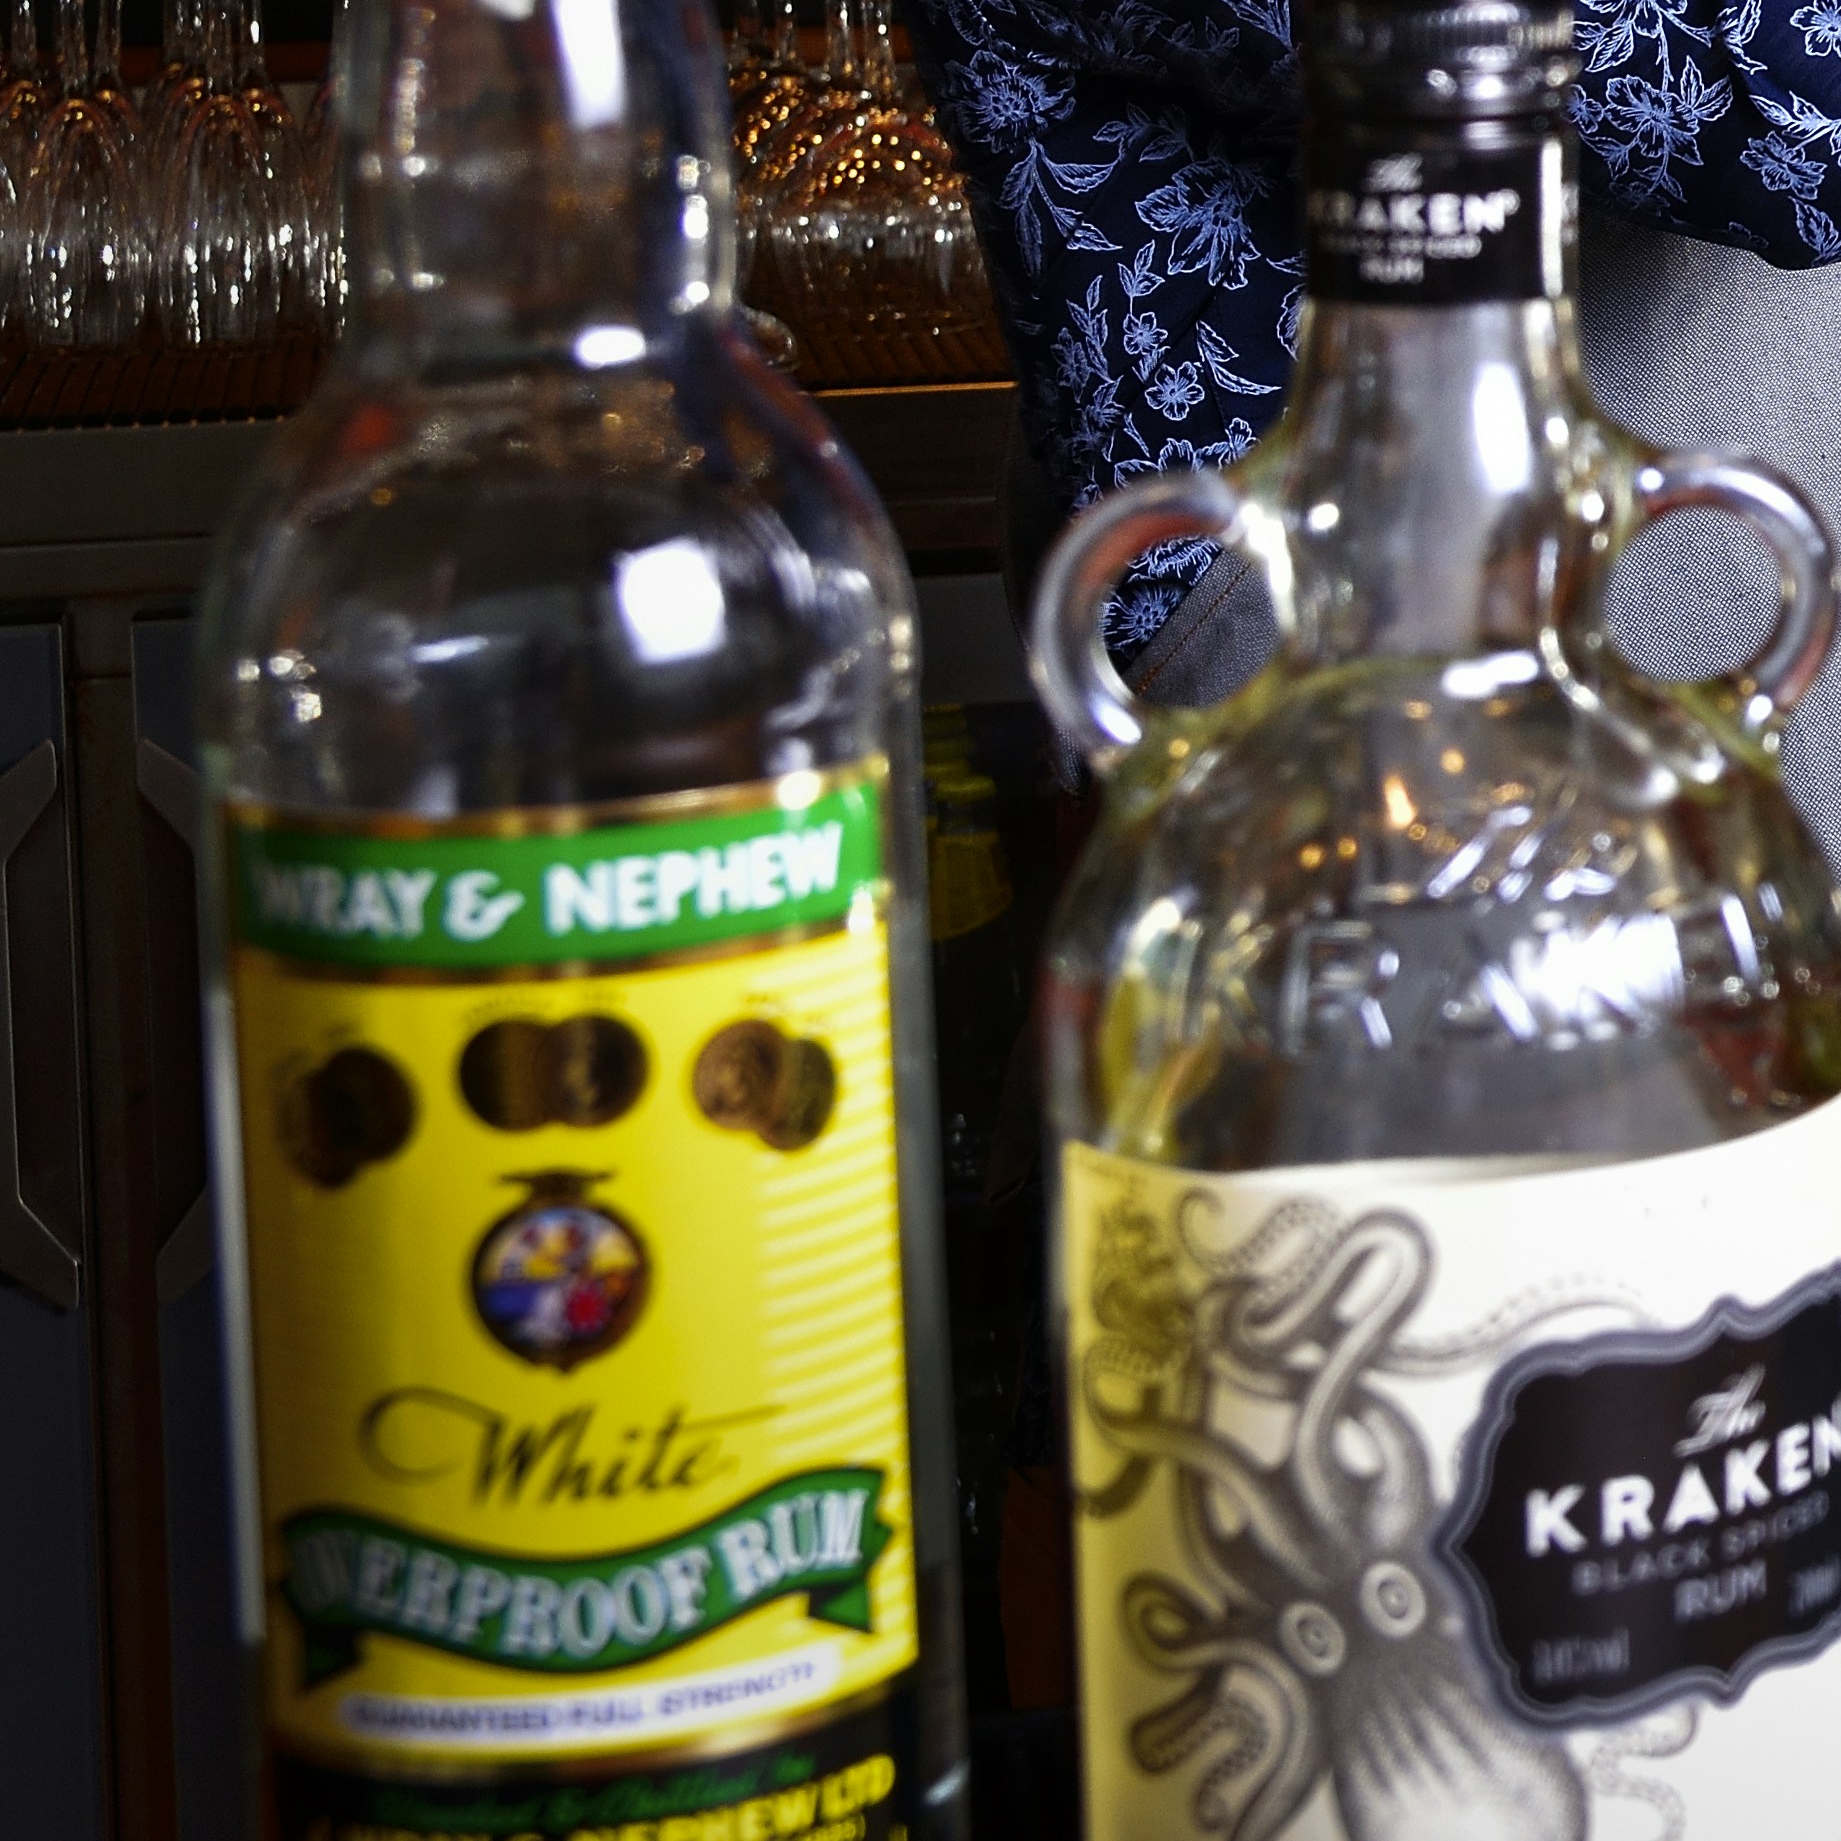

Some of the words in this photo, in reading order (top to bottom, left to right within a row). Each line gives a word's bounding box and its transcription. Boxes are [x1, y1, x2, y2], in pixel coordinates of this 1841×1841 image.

[249, 861, 437, 940] WRAY
[442, 870, 525, 942] &
[544, 822, 843, 935] NEPHEW
[358, 1386, 786, 1512] White
[299, 1522, 712, 1659] OVERPROOF
[714, 1488, 871, 1599] RUM
[1673, 1561, 1767, 1622] RUM
